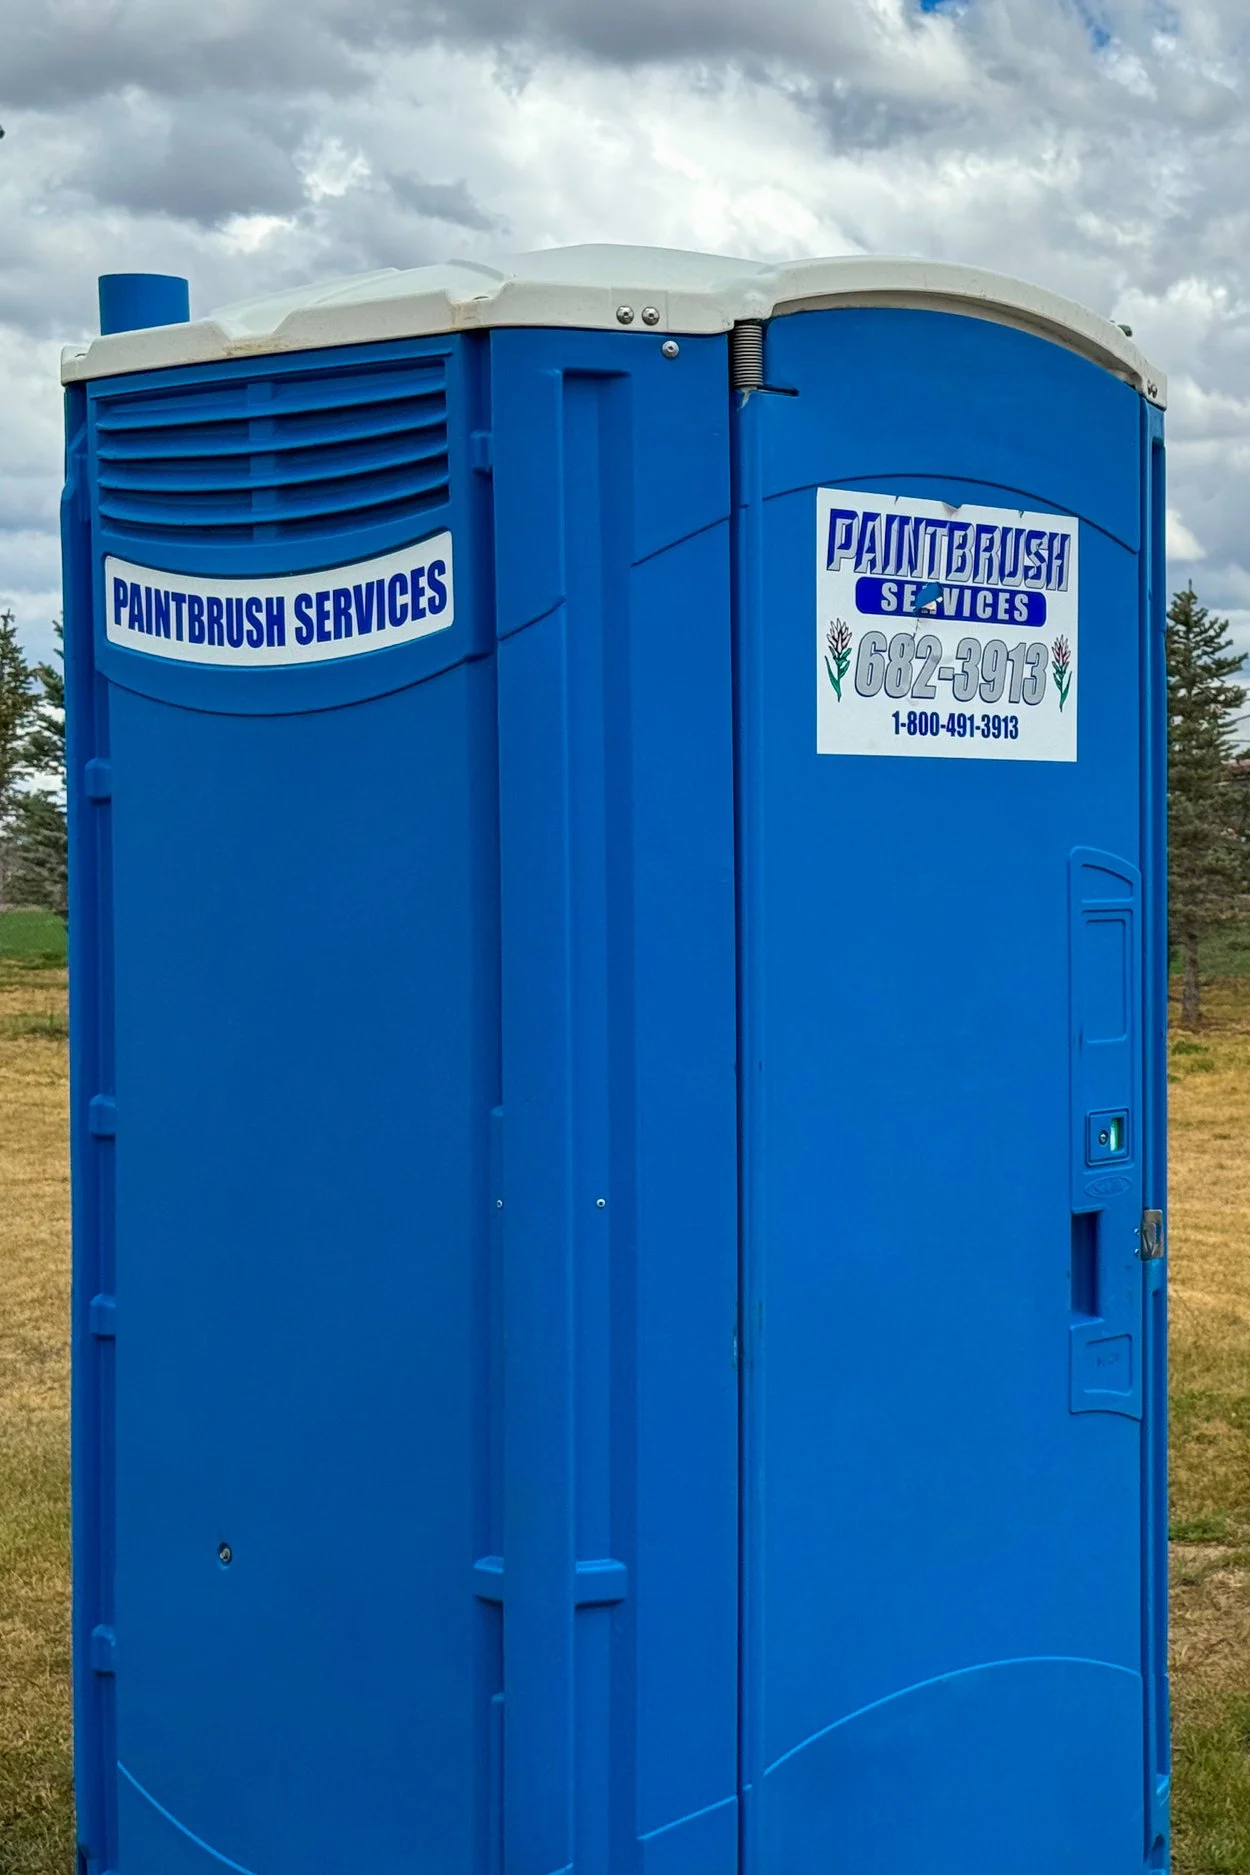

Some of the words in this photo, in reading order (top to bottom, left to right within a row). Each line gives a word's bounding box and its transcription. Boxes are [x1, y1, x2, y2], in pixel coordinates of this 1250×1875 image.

[826, 508, 1071, 592] PAINTBRUSH
[113, 576, 285, 649] PAINTBRUSH
[294, 559, 448, 646] SERVICES
[854, 630, 1049, 706] 682-3913
[892, 710, 1019, 740] 1-800-491-3913
